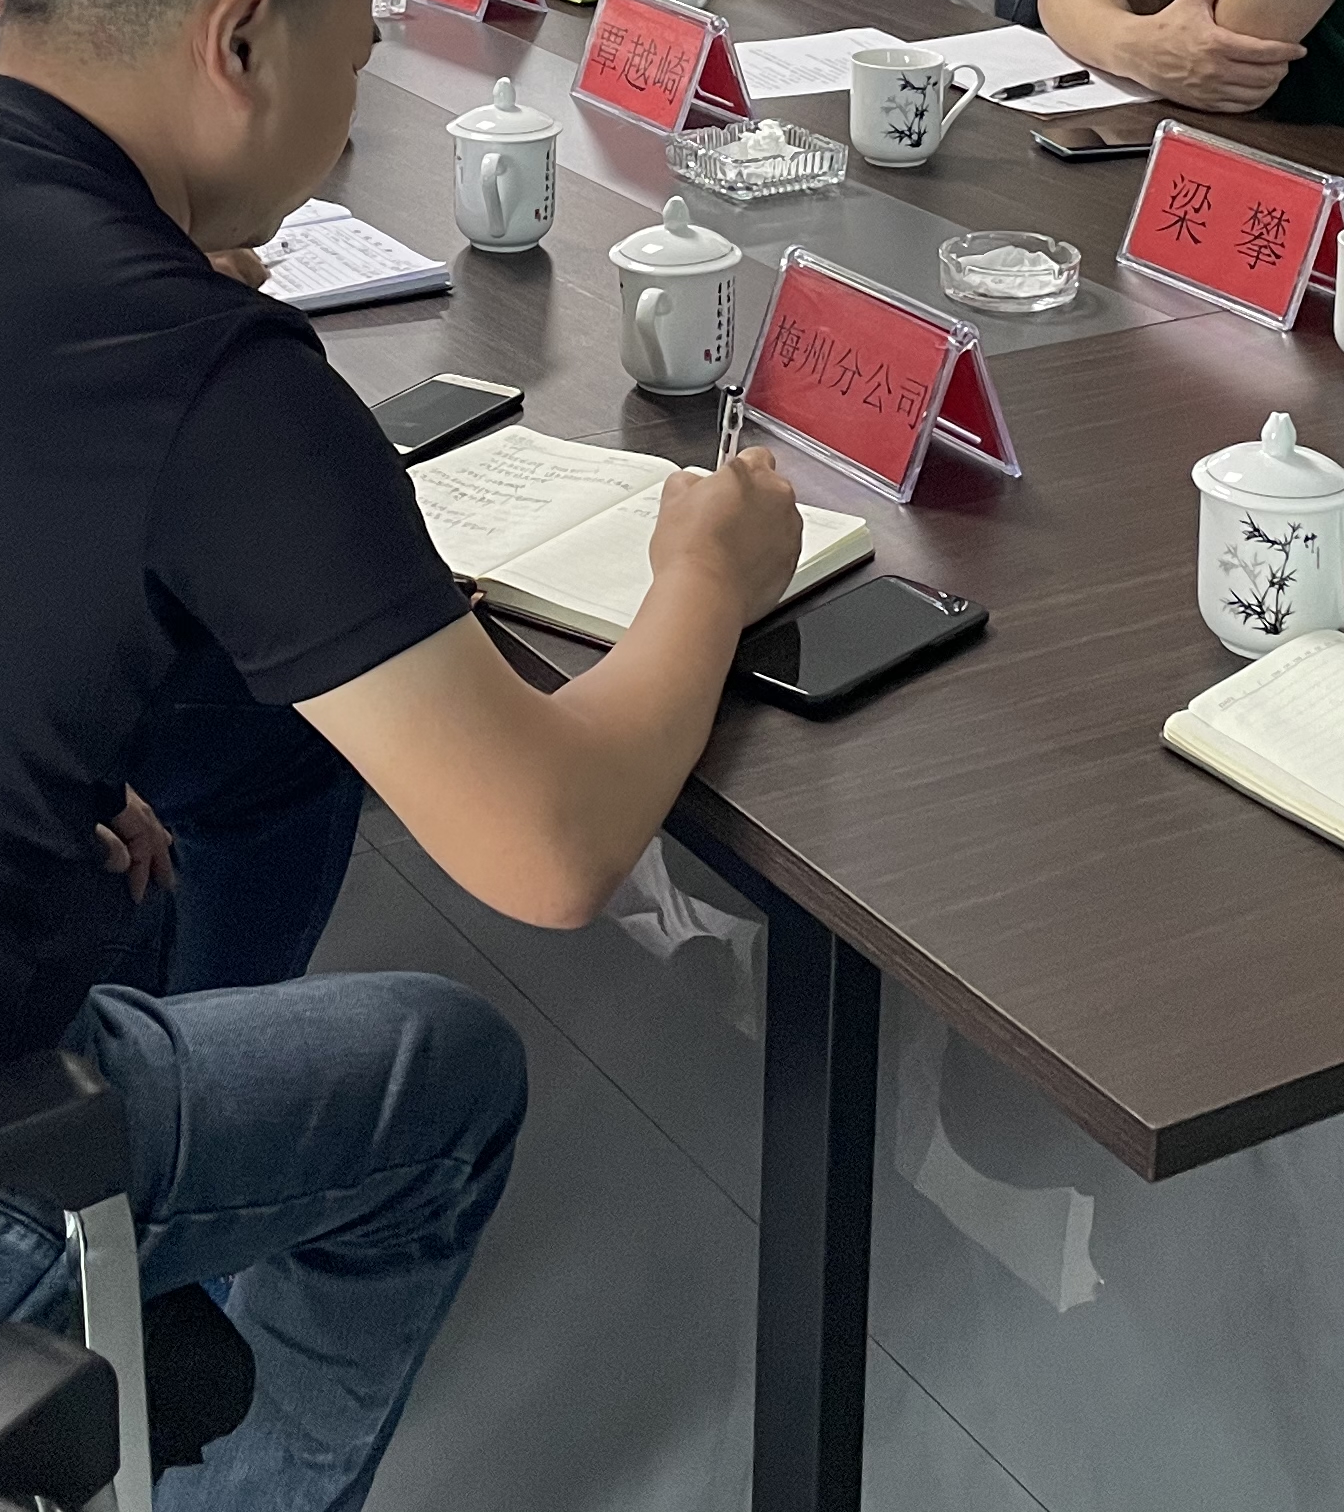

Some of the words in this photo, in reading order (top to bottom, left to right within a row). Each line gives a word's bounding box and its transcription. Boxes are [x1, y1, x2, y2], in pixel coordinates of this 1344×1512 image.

[590, 21, 692, 106] 覃越崎
[1155, 173, 1212, 245] 梁
[1234, 201, 1291, 270] 攀
[766, 313, 929, 430] 梅州分公司
